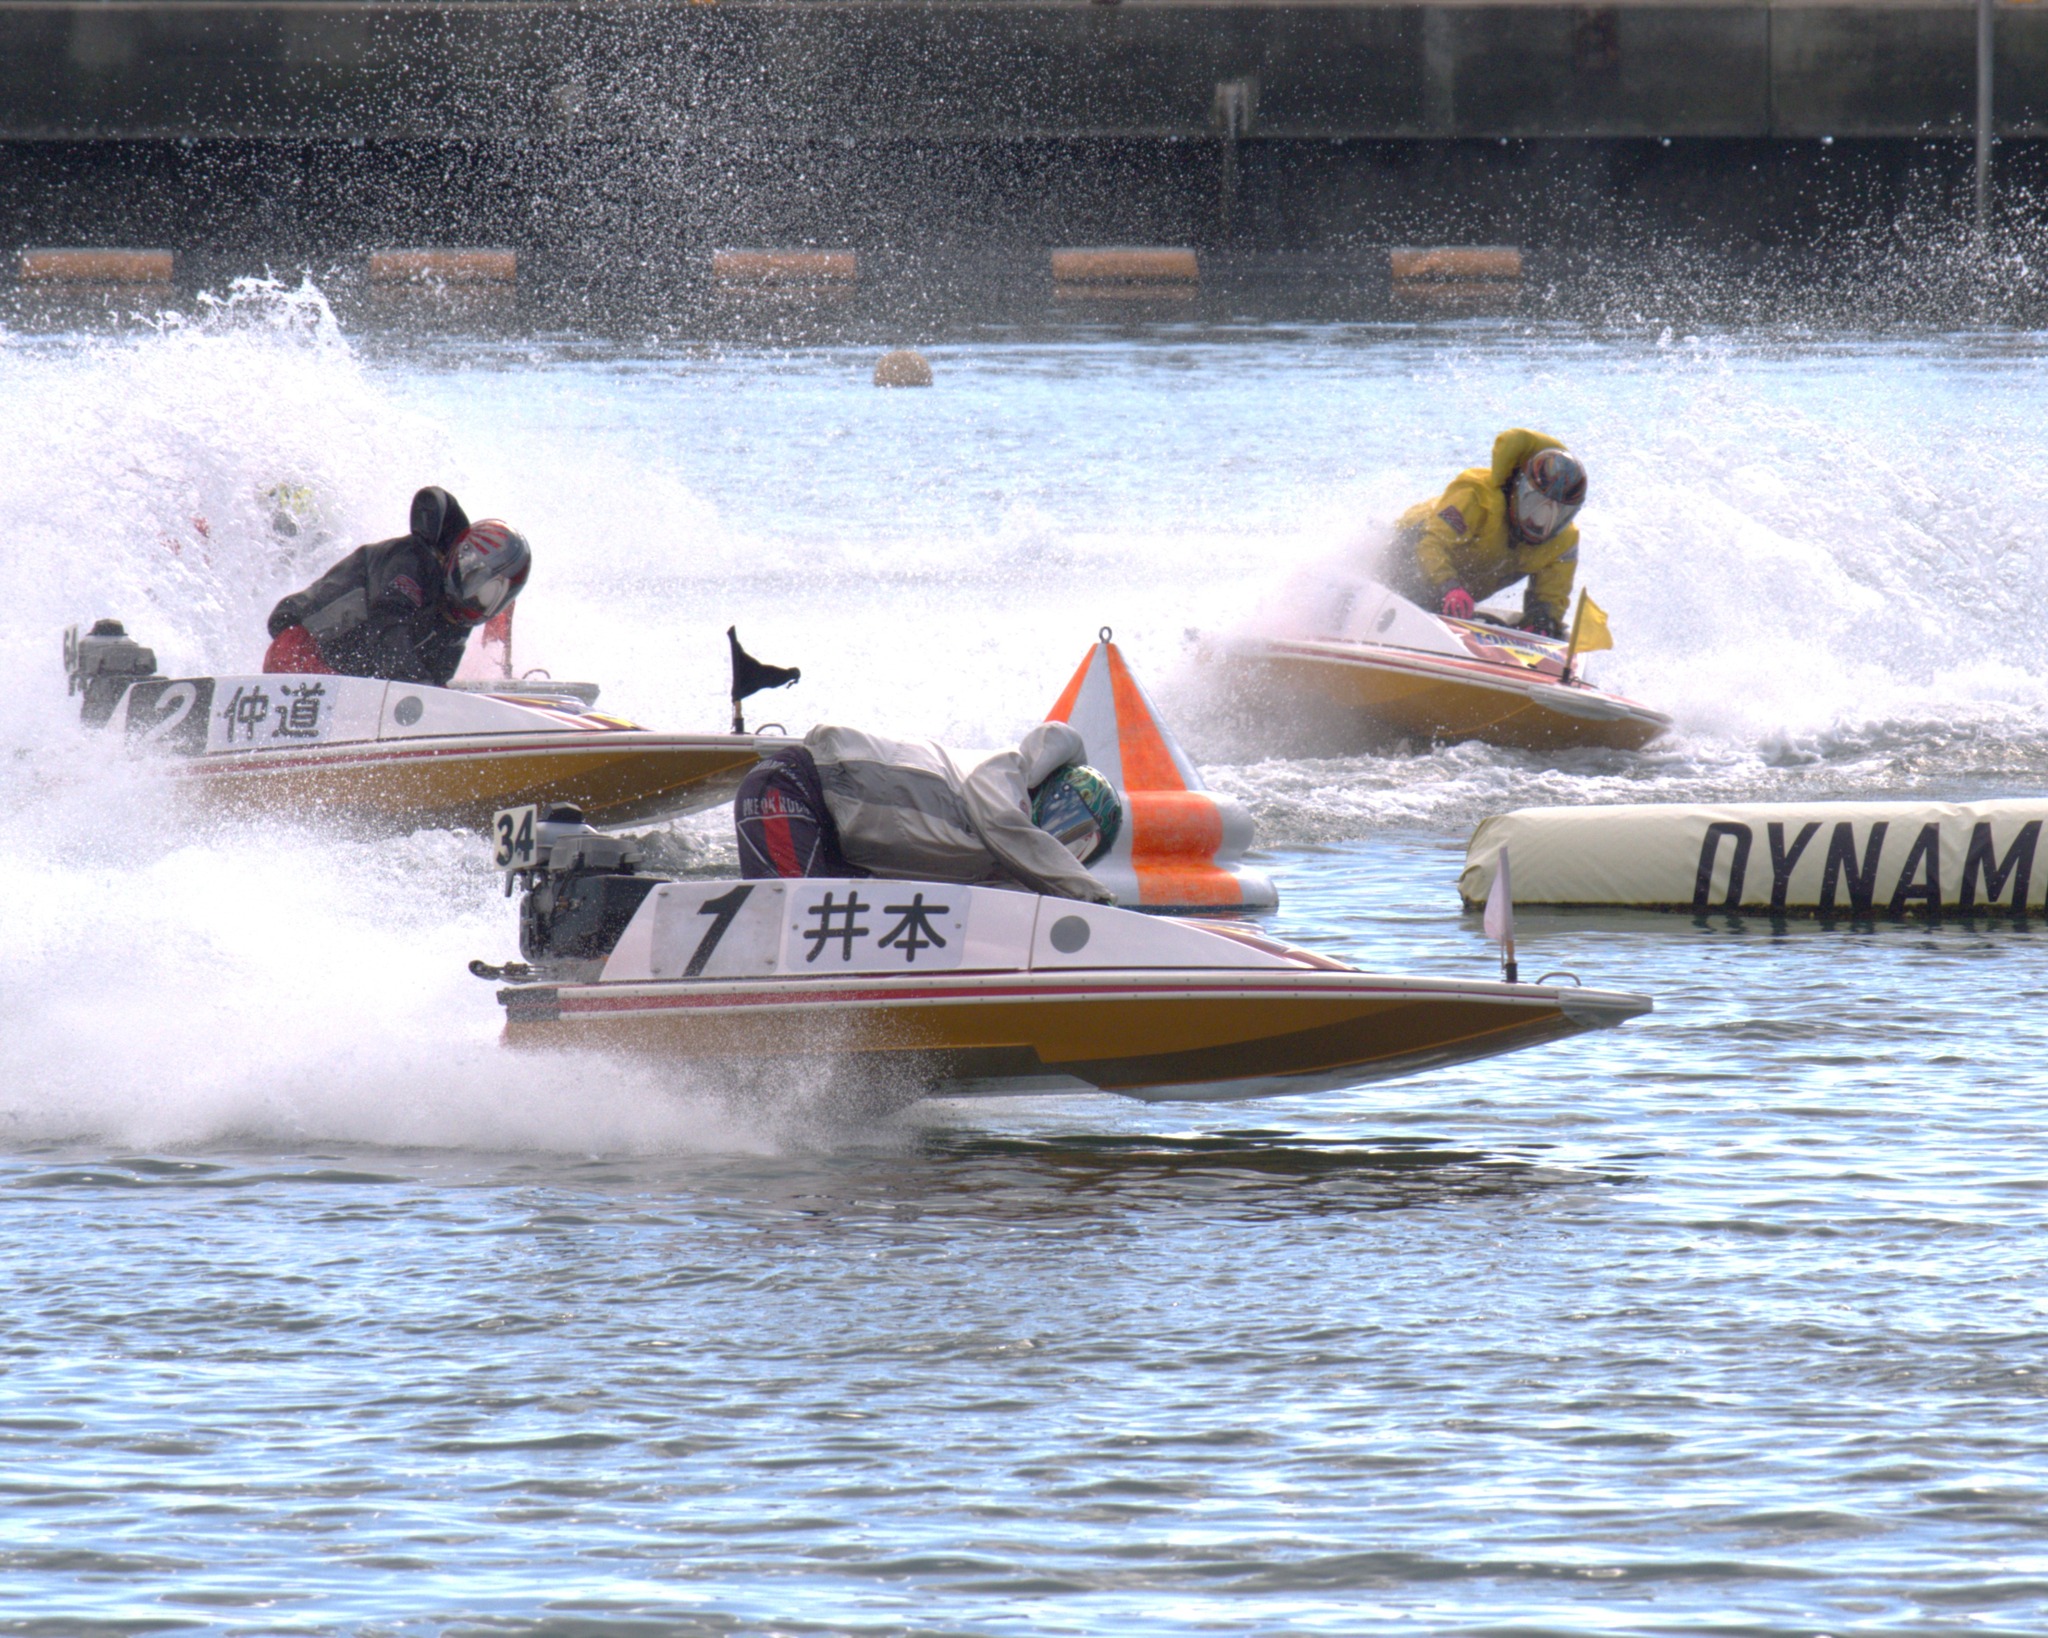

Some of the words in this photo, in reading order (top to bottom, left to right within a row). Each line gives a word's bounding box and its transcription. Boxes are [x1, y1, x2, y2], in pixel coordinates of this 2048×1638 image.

[144, 682, 197, 747] 2
[223, 682, 326, 743] 仲道
[496, 810, 534, 866] 34
[1692, 820, 2048, 914] DYNAM
[682, 885, 756, 977] 1
[803, 891, 950, 962] 井本
